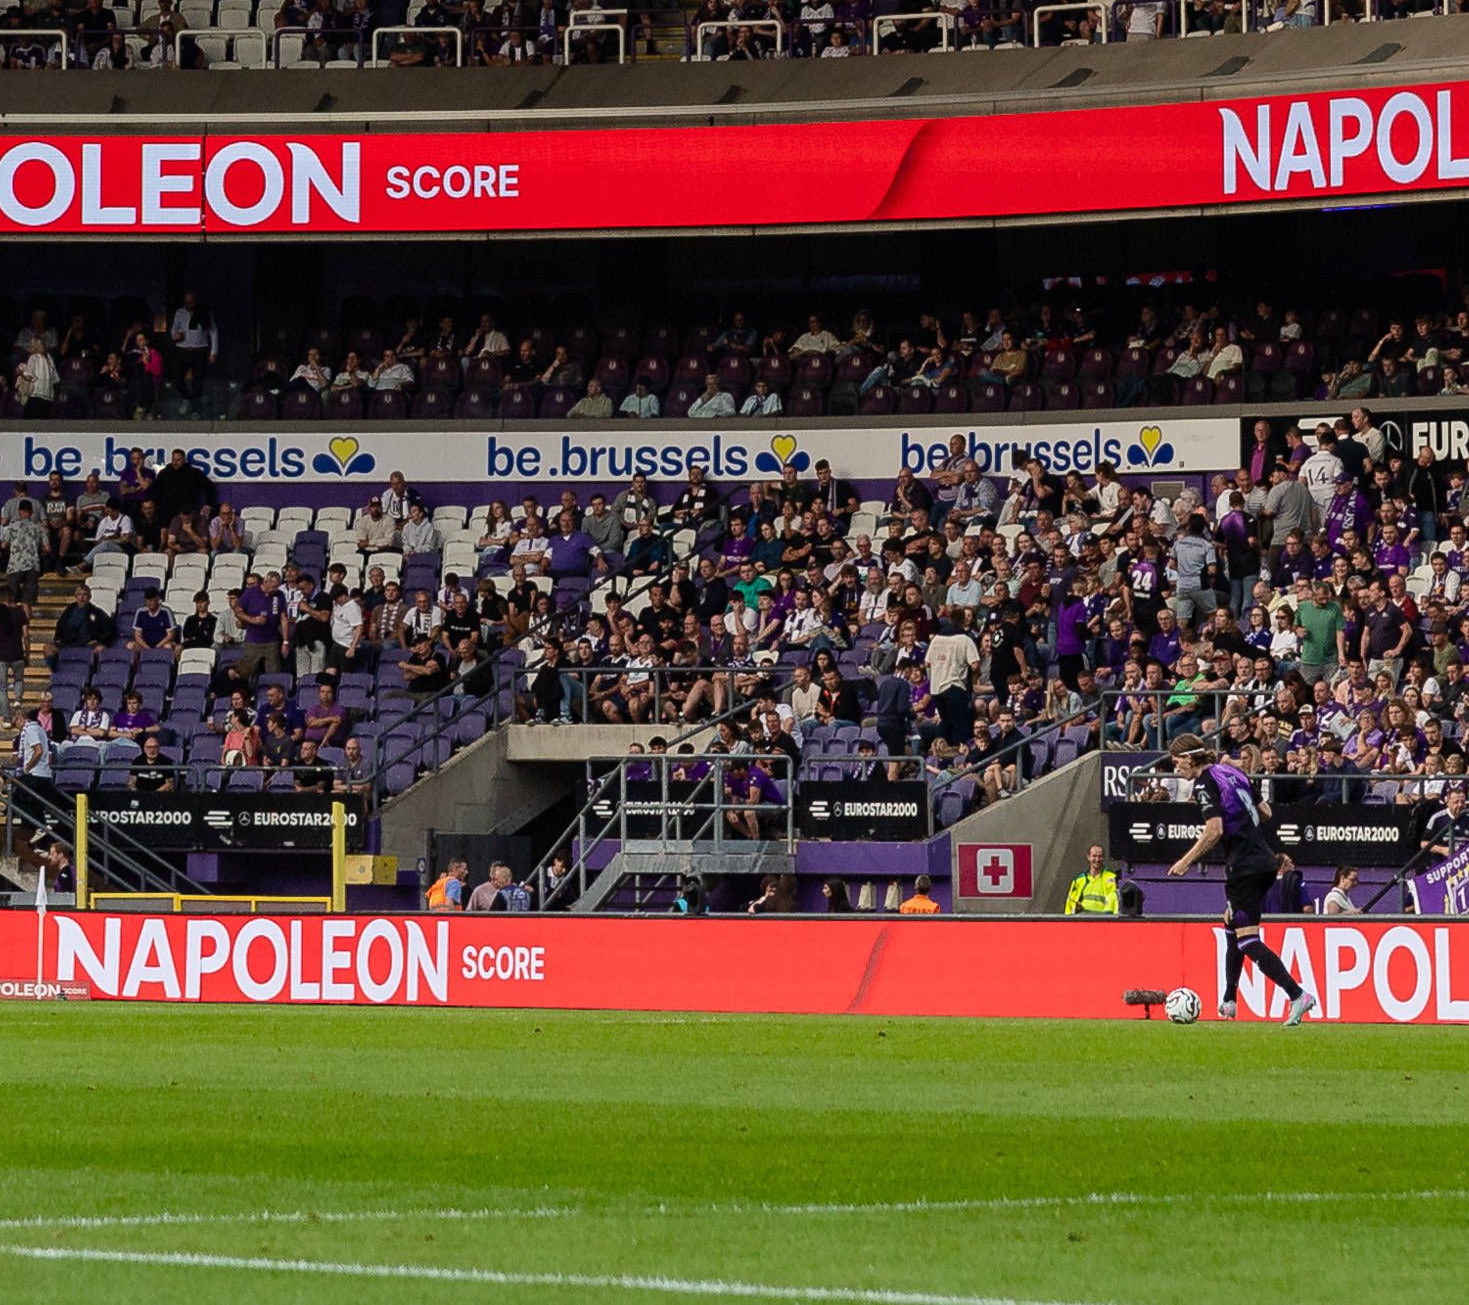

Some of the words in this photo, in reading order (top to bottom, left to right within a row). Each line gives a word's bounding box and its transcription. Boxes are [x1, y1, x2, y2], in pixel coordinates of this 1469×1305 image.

[385, 164, 520, 199] SCORE
[1307, 465, 1329, 486] 14
[1131, 569, 1153, 591] 24
[844, 802, 918, 817] EUROSTAR2000
[1316, 827, 1399, 841] EUROSTAR2000
[53, 915, 449, 1003] NAPOLEON
[461, 945, 545, 981] SCORE
